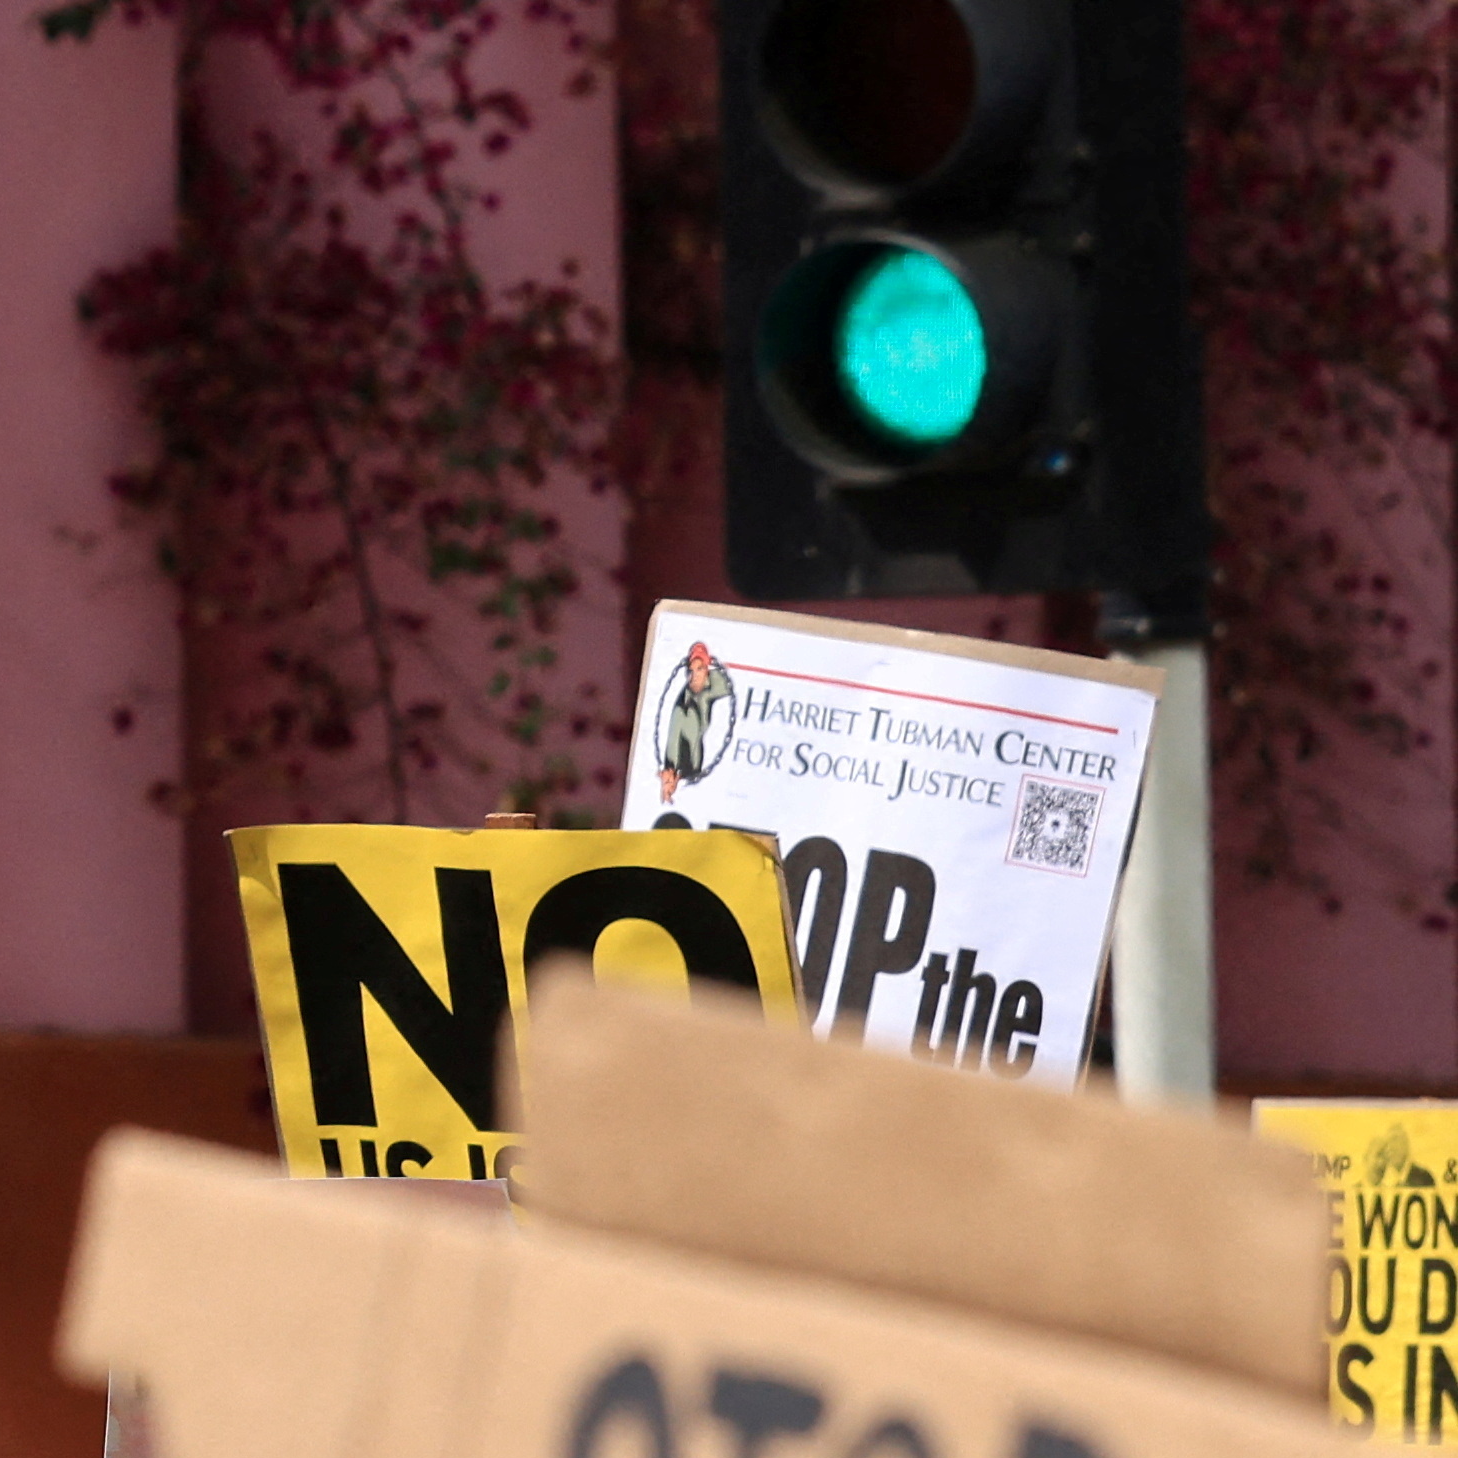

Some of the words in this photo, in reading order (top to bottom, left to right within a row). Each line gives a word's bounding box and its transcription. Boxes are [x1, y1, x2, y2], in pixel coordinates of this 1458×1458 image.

[732, 738, 782, 769] FOR
[789, 742, 883, 787] SOCIAL
[888, 759, 1007, 808] JUSTICE
[741, 687, 858, 737] HARRIET
[869, 707, 985, 755] TUBMAN
[994, 729, 1118, 781] CENTER
[652, 811, 936, 1050] OP
[909, 946, 1044, 1081] the
